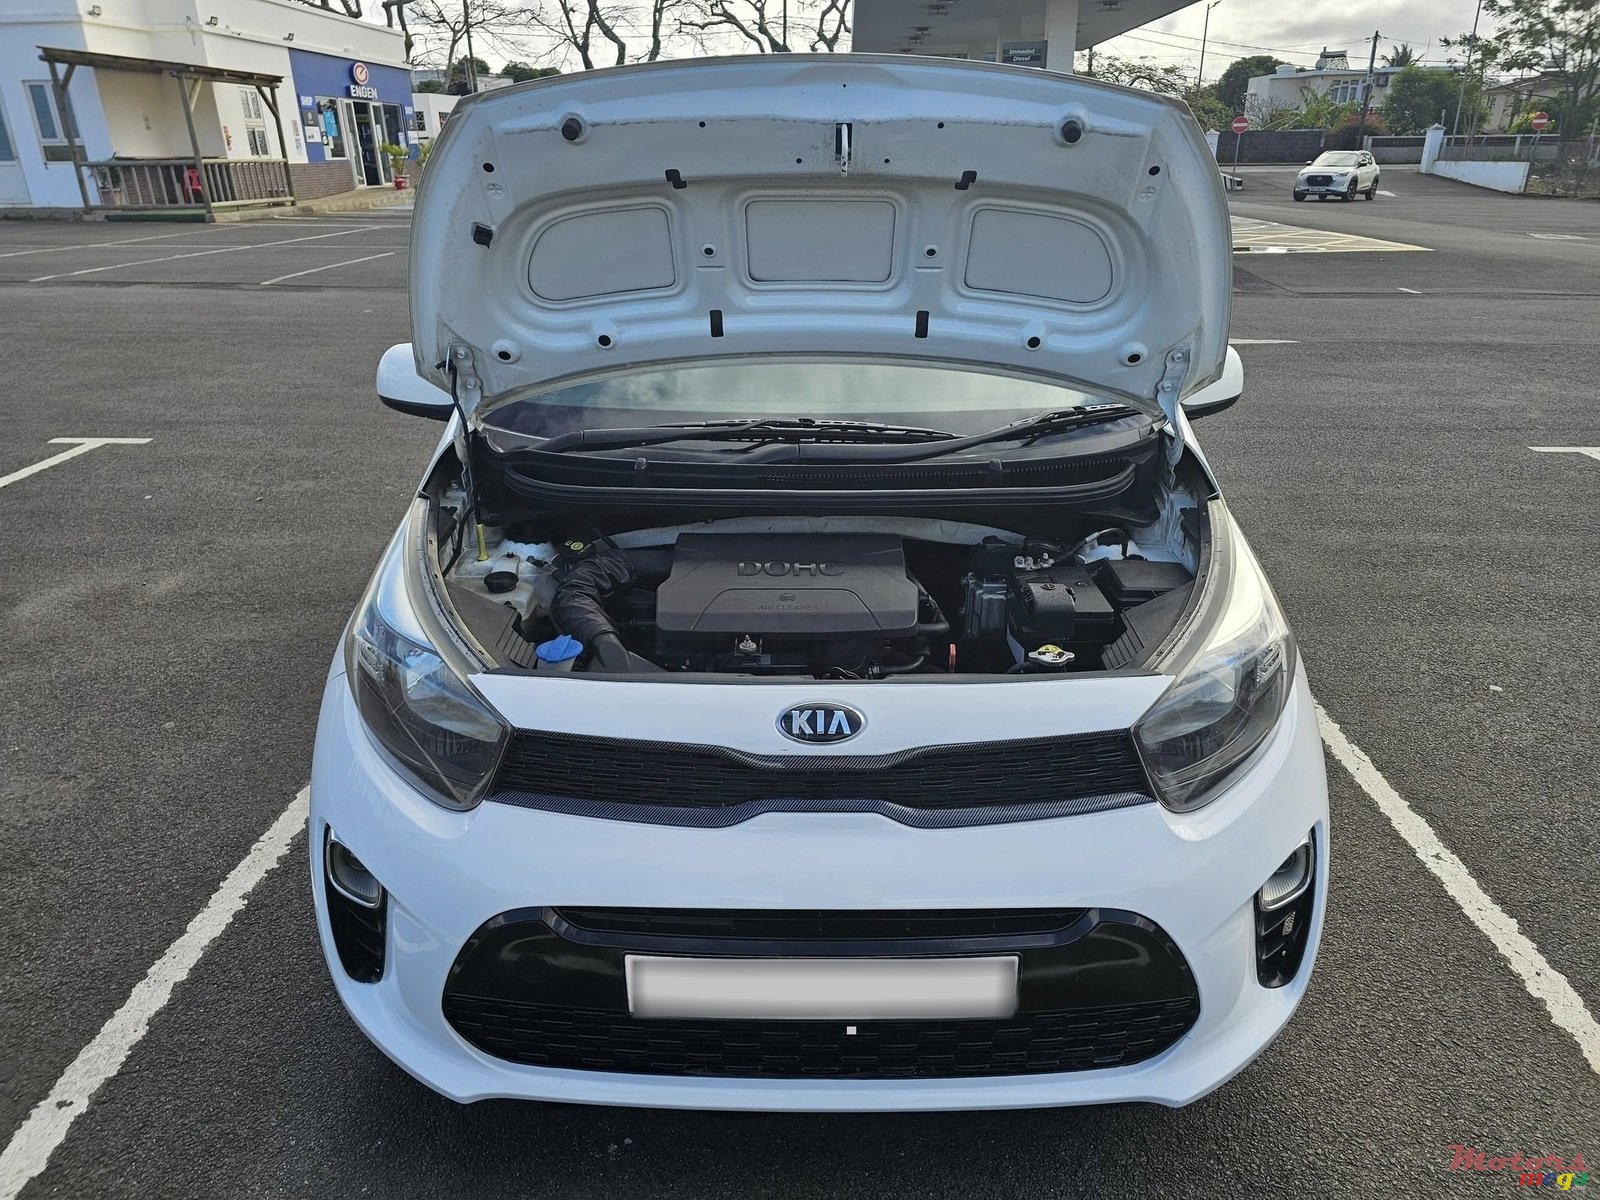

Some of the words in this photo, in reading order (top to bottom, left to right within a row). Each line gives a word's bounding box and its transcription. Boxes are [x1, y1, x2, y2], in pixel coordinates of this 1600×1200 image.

[350, 85, 378, 99] ENGEN
[737, 560, 846, 577] DOHC
[791, 709, 851, 735] KIA
